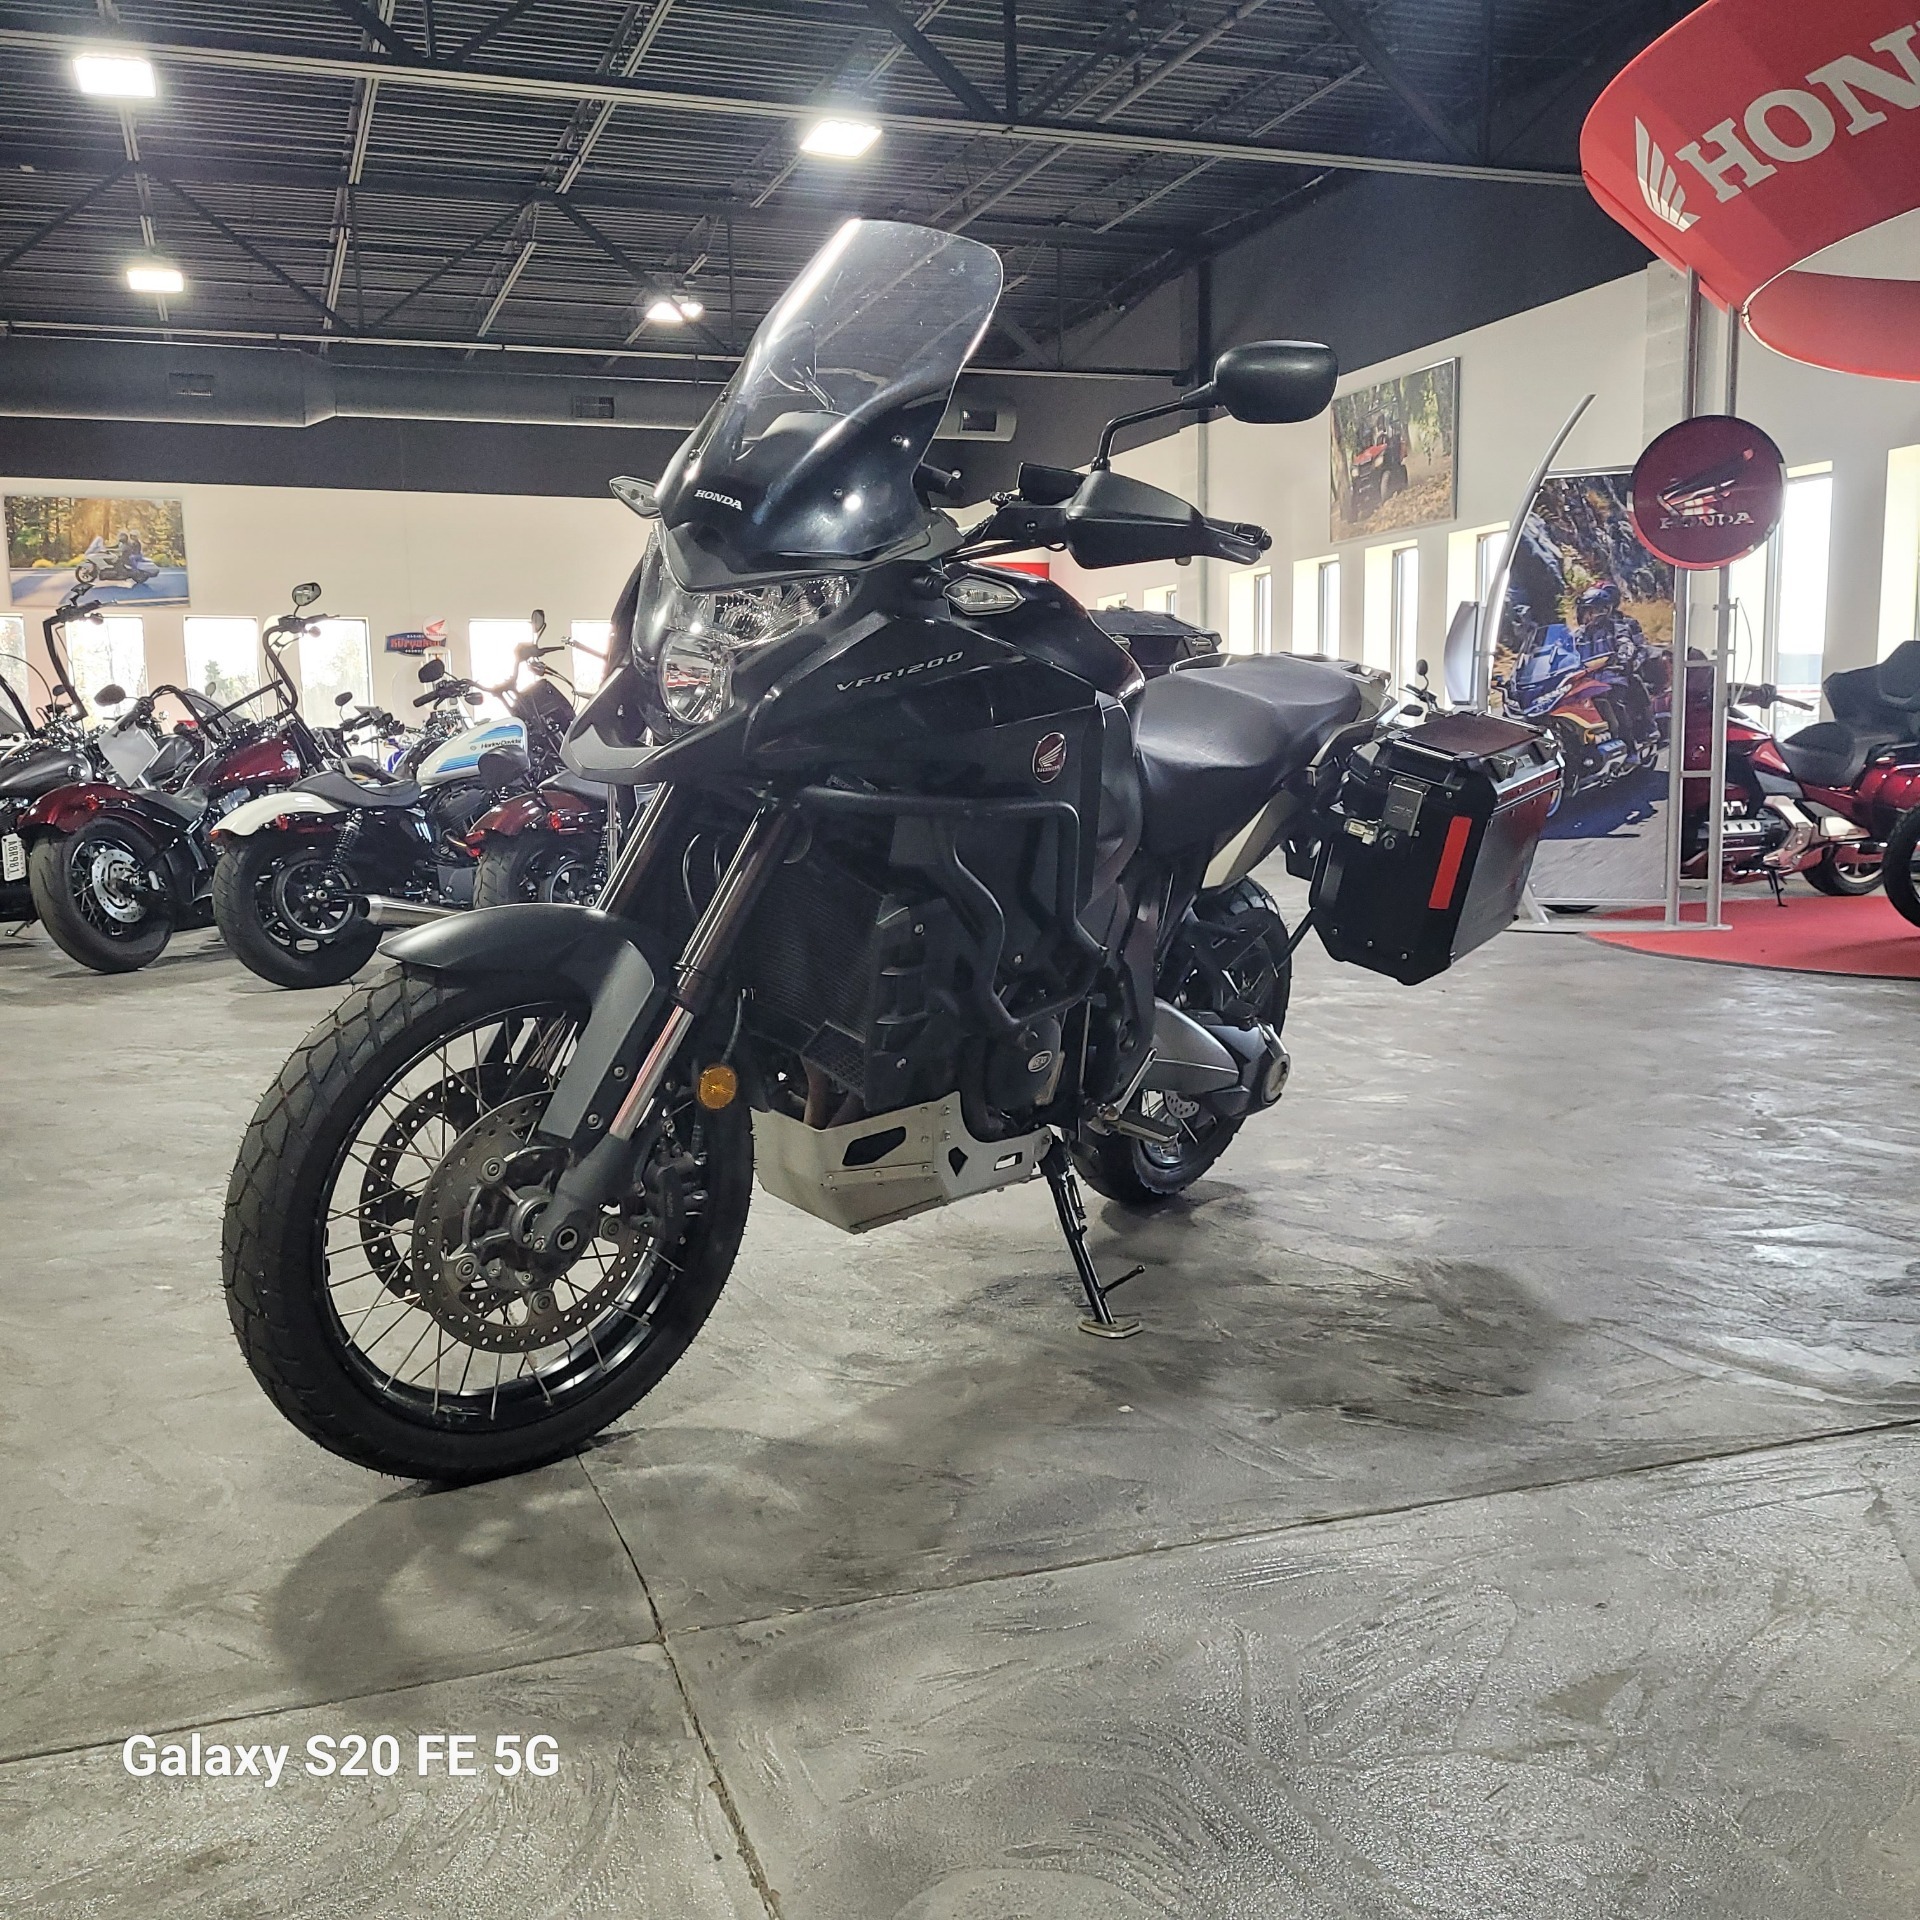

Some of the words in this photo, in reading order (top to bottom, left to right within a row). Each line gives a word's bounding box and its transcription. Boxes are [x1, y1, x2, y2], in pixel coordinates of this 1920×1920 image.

[1675, 20, 1920, 203] HON
[694, 489, 743, 511] HONDA
[836, 651, 964, 691] VFR1200
[7, 841, 20, 873] A8R981
